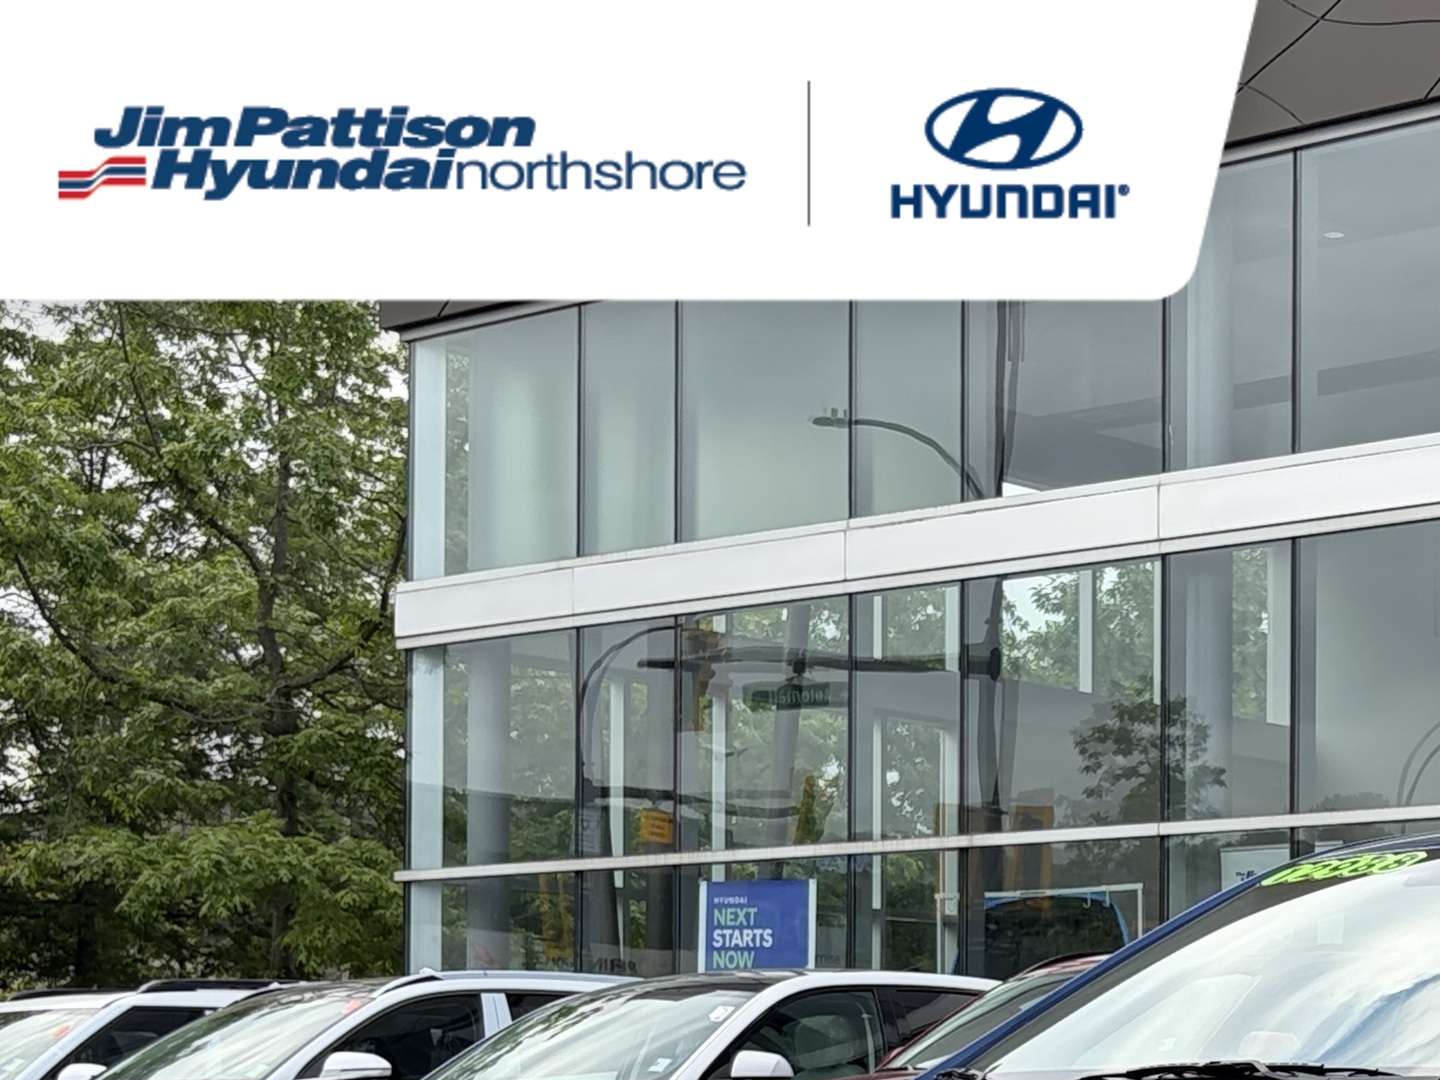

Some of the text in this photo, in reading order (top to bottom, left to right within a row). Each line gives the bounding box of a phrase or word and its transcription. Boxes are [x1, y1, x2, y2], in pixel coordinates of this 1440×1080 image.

[713, 907, 758, 926] NEXT
[712, 928, 773, 948] STARTS
[712, 950, 755, 969] NOW
